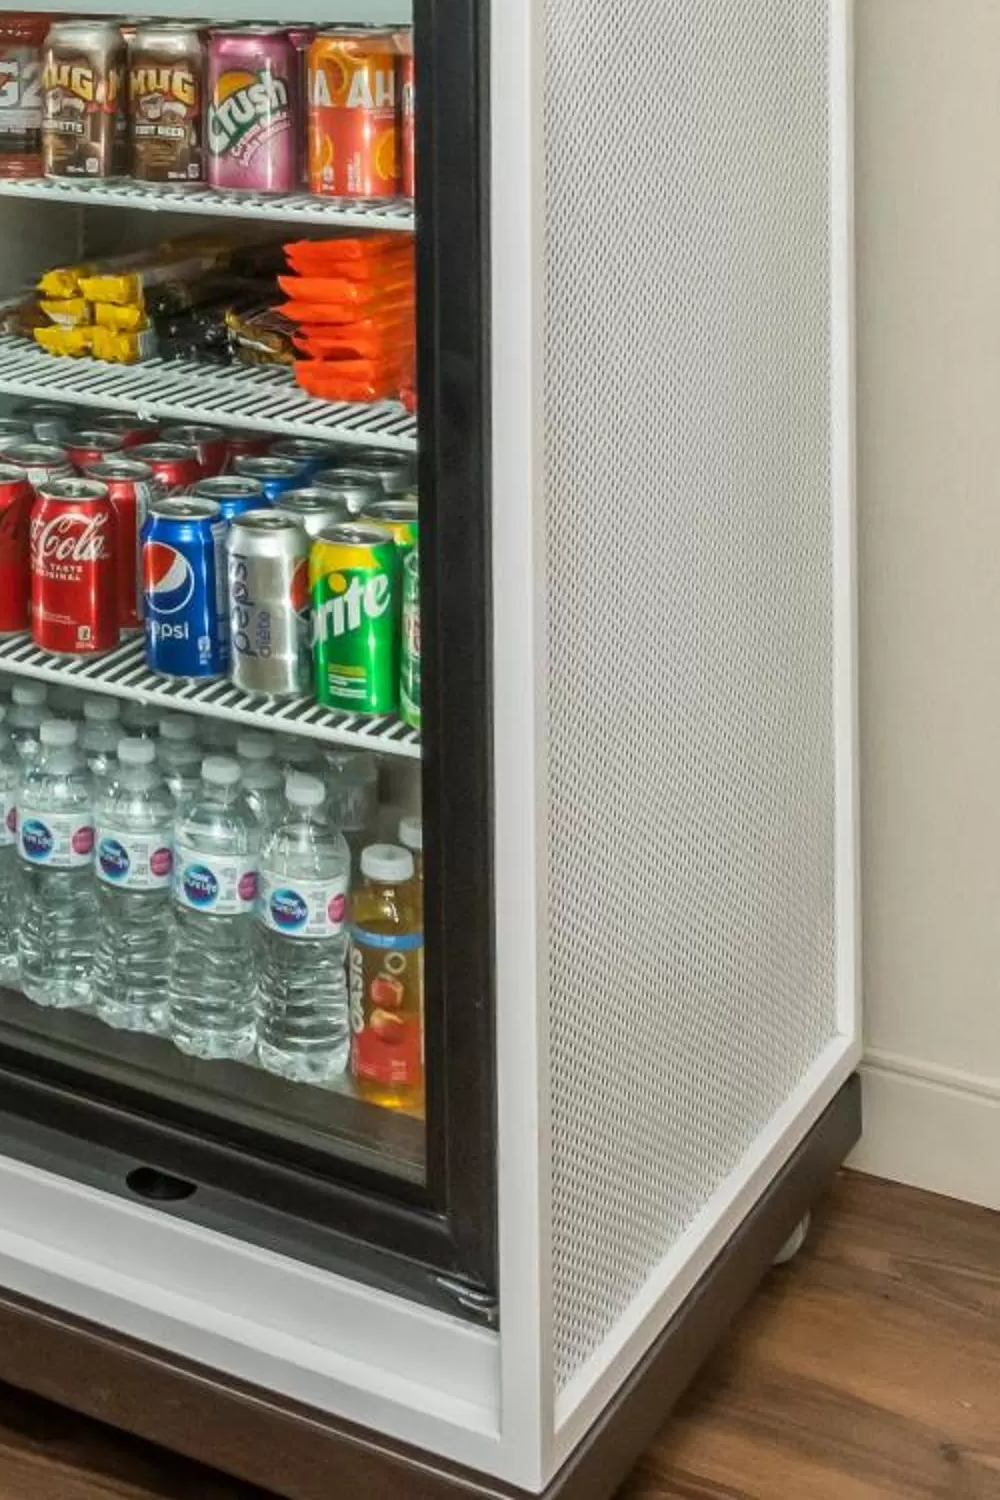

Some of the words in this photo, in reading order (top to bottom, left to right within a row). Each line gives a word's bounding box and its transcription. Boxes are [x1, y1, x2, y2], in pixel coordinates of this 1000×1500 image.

[208, 66, 288, 153] Crush
[38, 512, 108, 562] Cola
[232, 553, 257, 660] pepsi
[313, 573, 391, 645] rite
